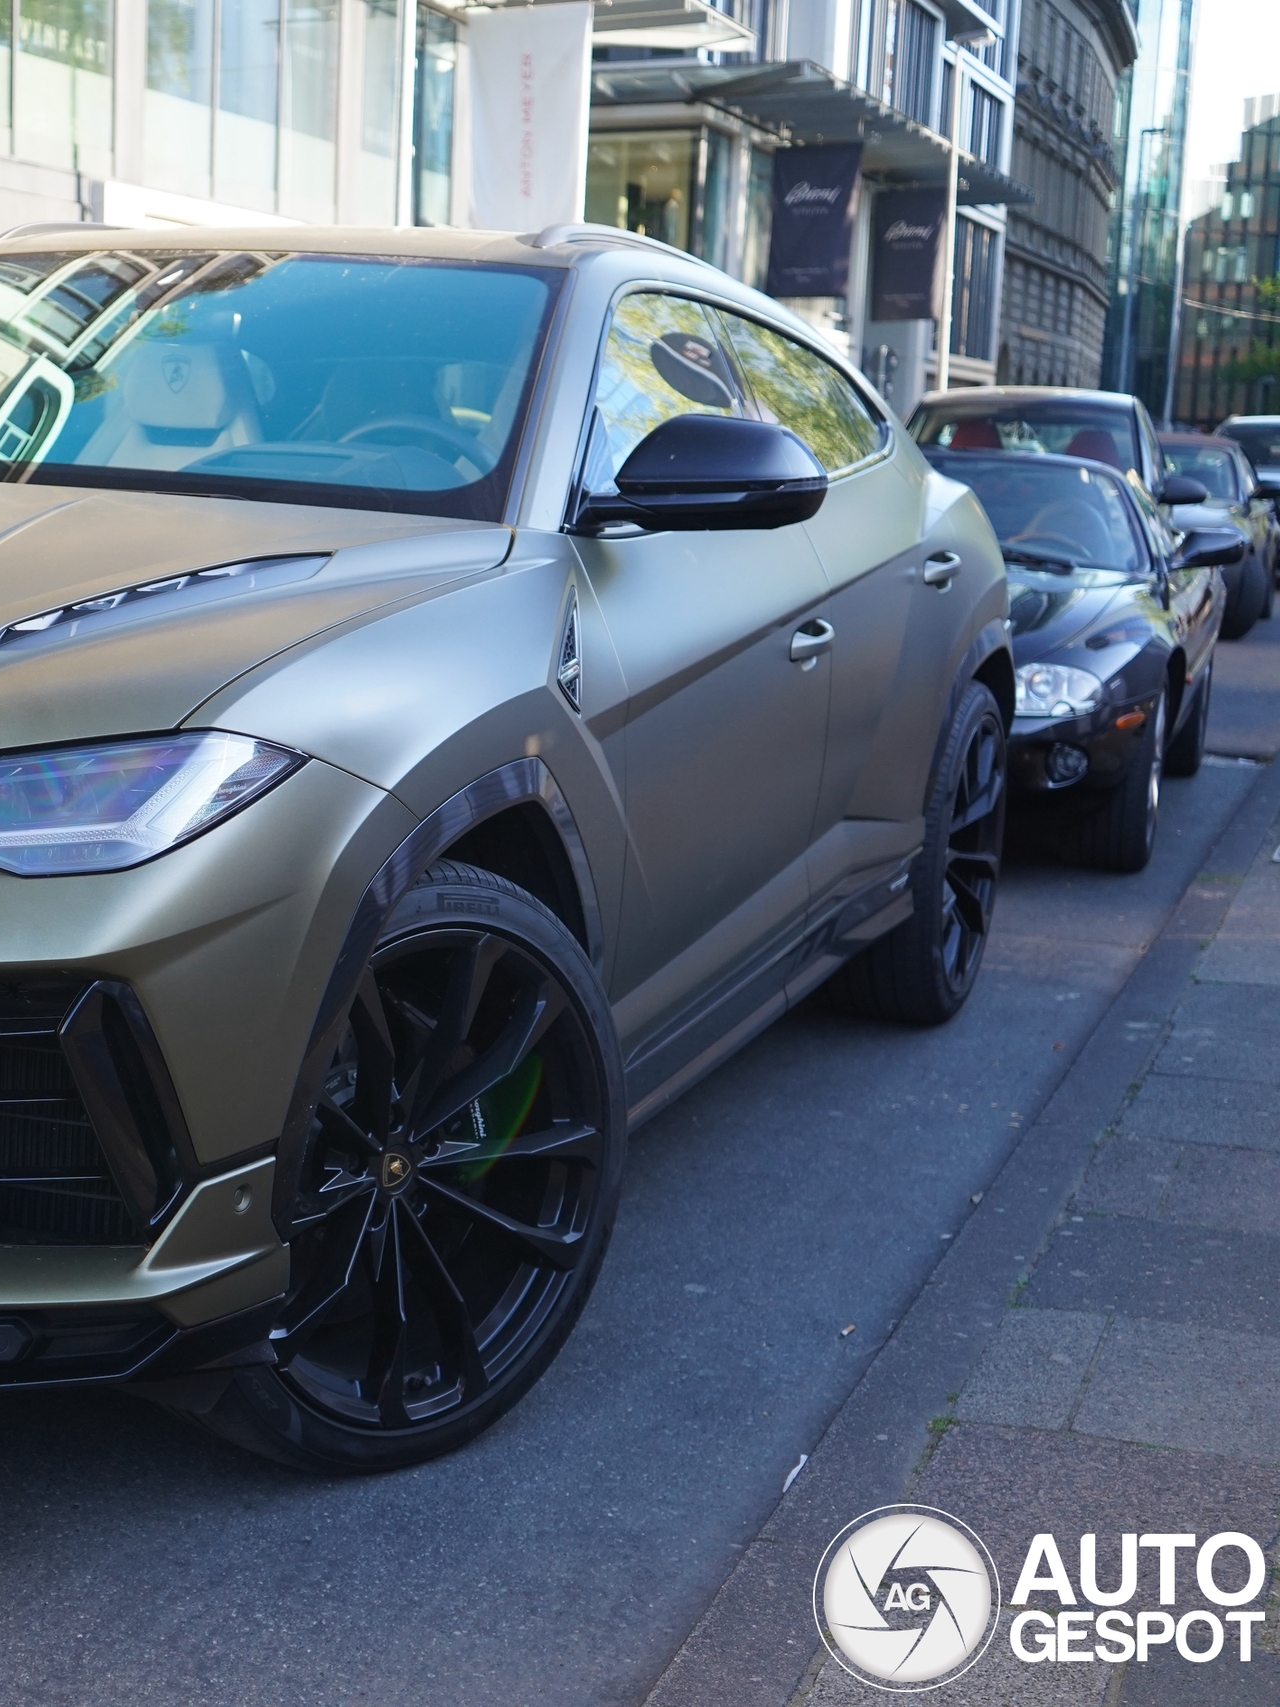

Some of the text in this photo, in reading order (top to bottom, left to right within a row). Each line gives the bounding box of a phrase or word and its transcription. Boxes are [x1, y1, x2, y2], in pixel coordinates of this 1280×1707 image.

[521, 54, 533, 198] ANTON MEYER
[436, 892, 500, 916] PIRELLI
